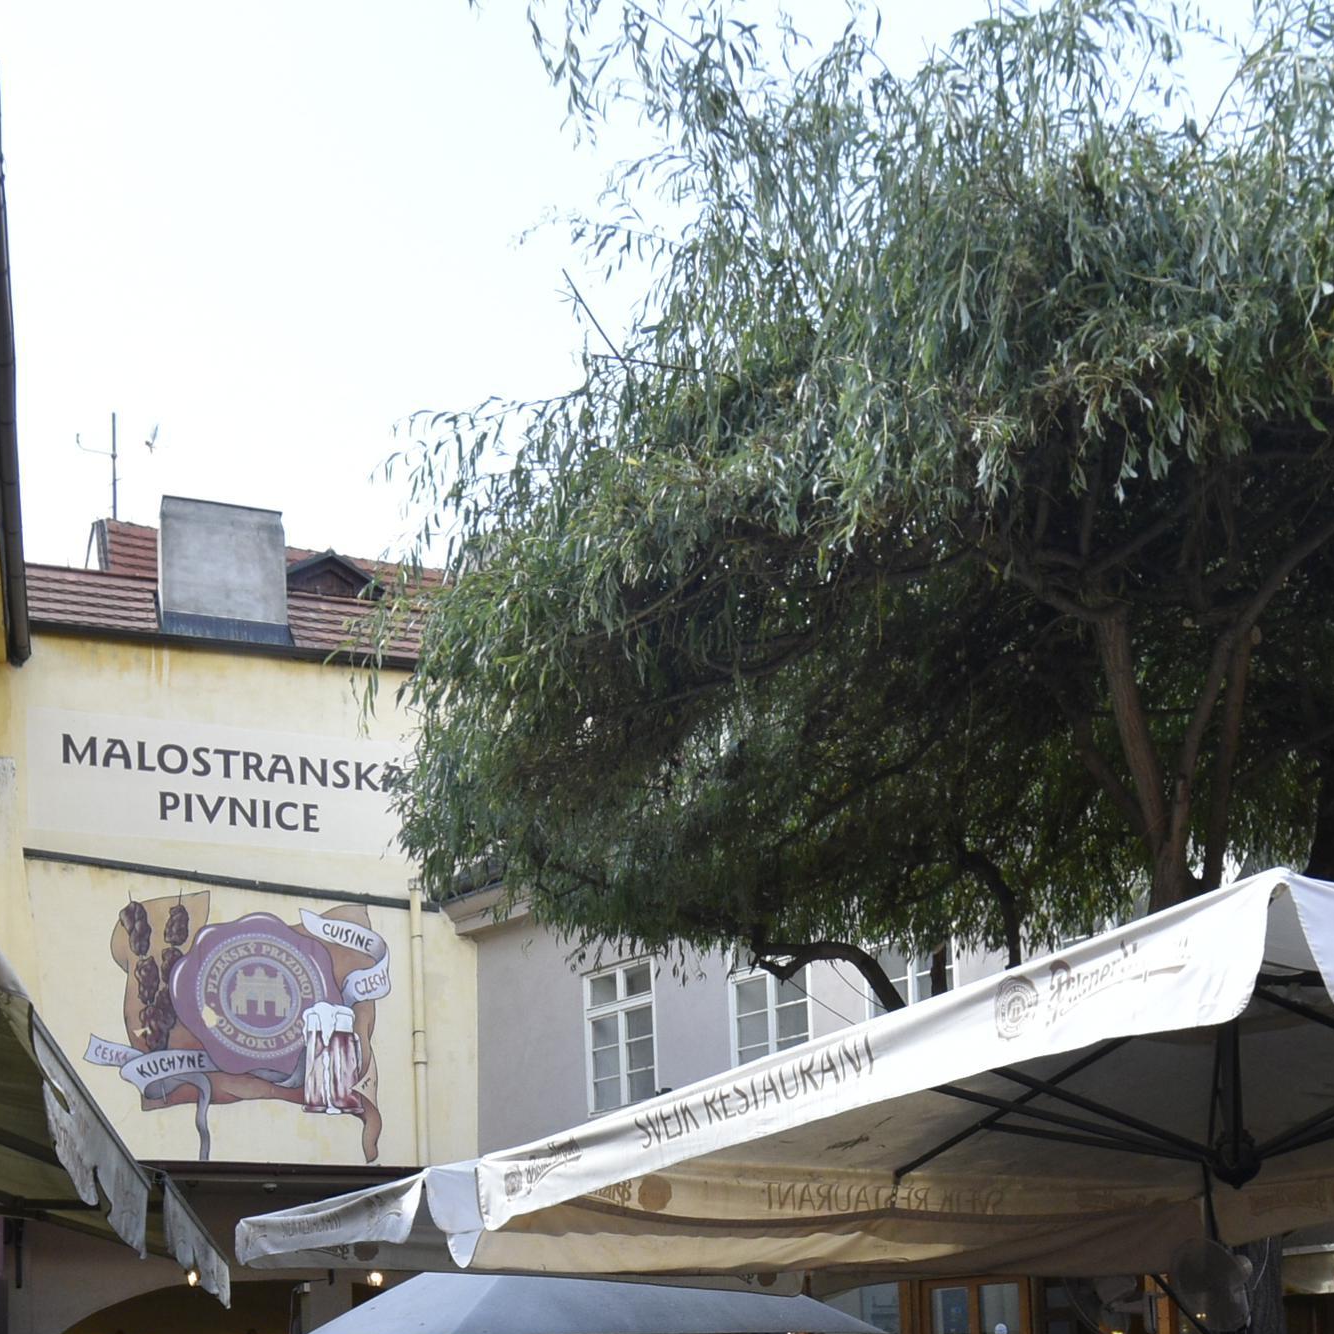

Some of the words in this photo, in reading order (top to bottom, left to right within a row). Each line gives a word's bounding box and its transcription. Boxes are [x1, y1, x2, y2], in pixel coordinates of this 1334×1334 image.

[159, 790, 320, 833] PIVNICE
[322, 922, 373, 952] CUISINE
[207, 941, 257, 994] PLZEŇSKÝ
[261, 944, 314, 999] PRAZDROJ
[354, 969, 388, 996] CZECH
[217, 1015, 235, 1036] OD
[236, 1035, 277, 1050] ROKU
